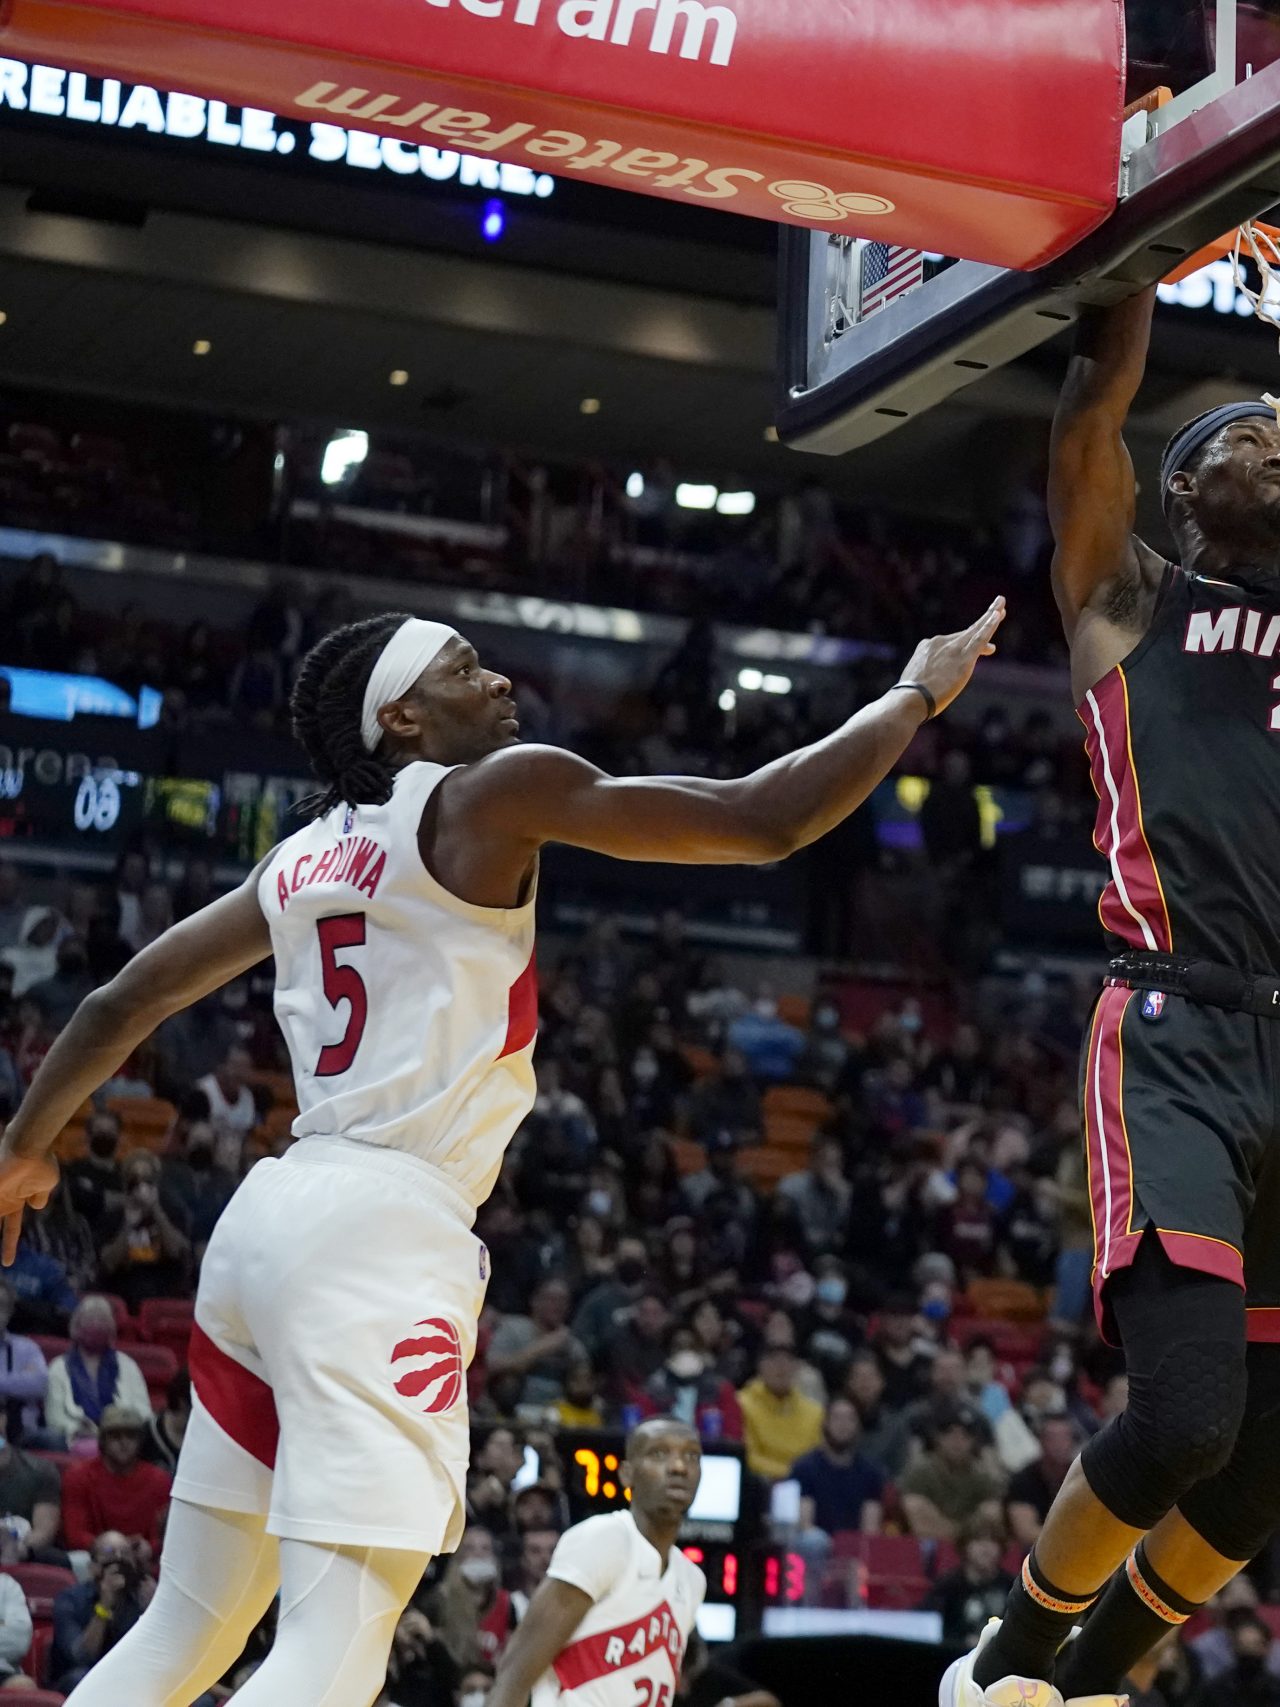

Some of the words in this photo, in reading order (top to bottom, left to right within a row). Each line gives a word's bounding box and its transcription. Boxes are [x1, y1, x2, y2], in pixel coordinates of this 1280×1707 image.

[0, 57, 296, 155] RELIABLE.
[309, 121, 555, 199] SECURE.
[278, 836, 388, 912] ACHIUWA
[313, 911, 368, 1077] 5
